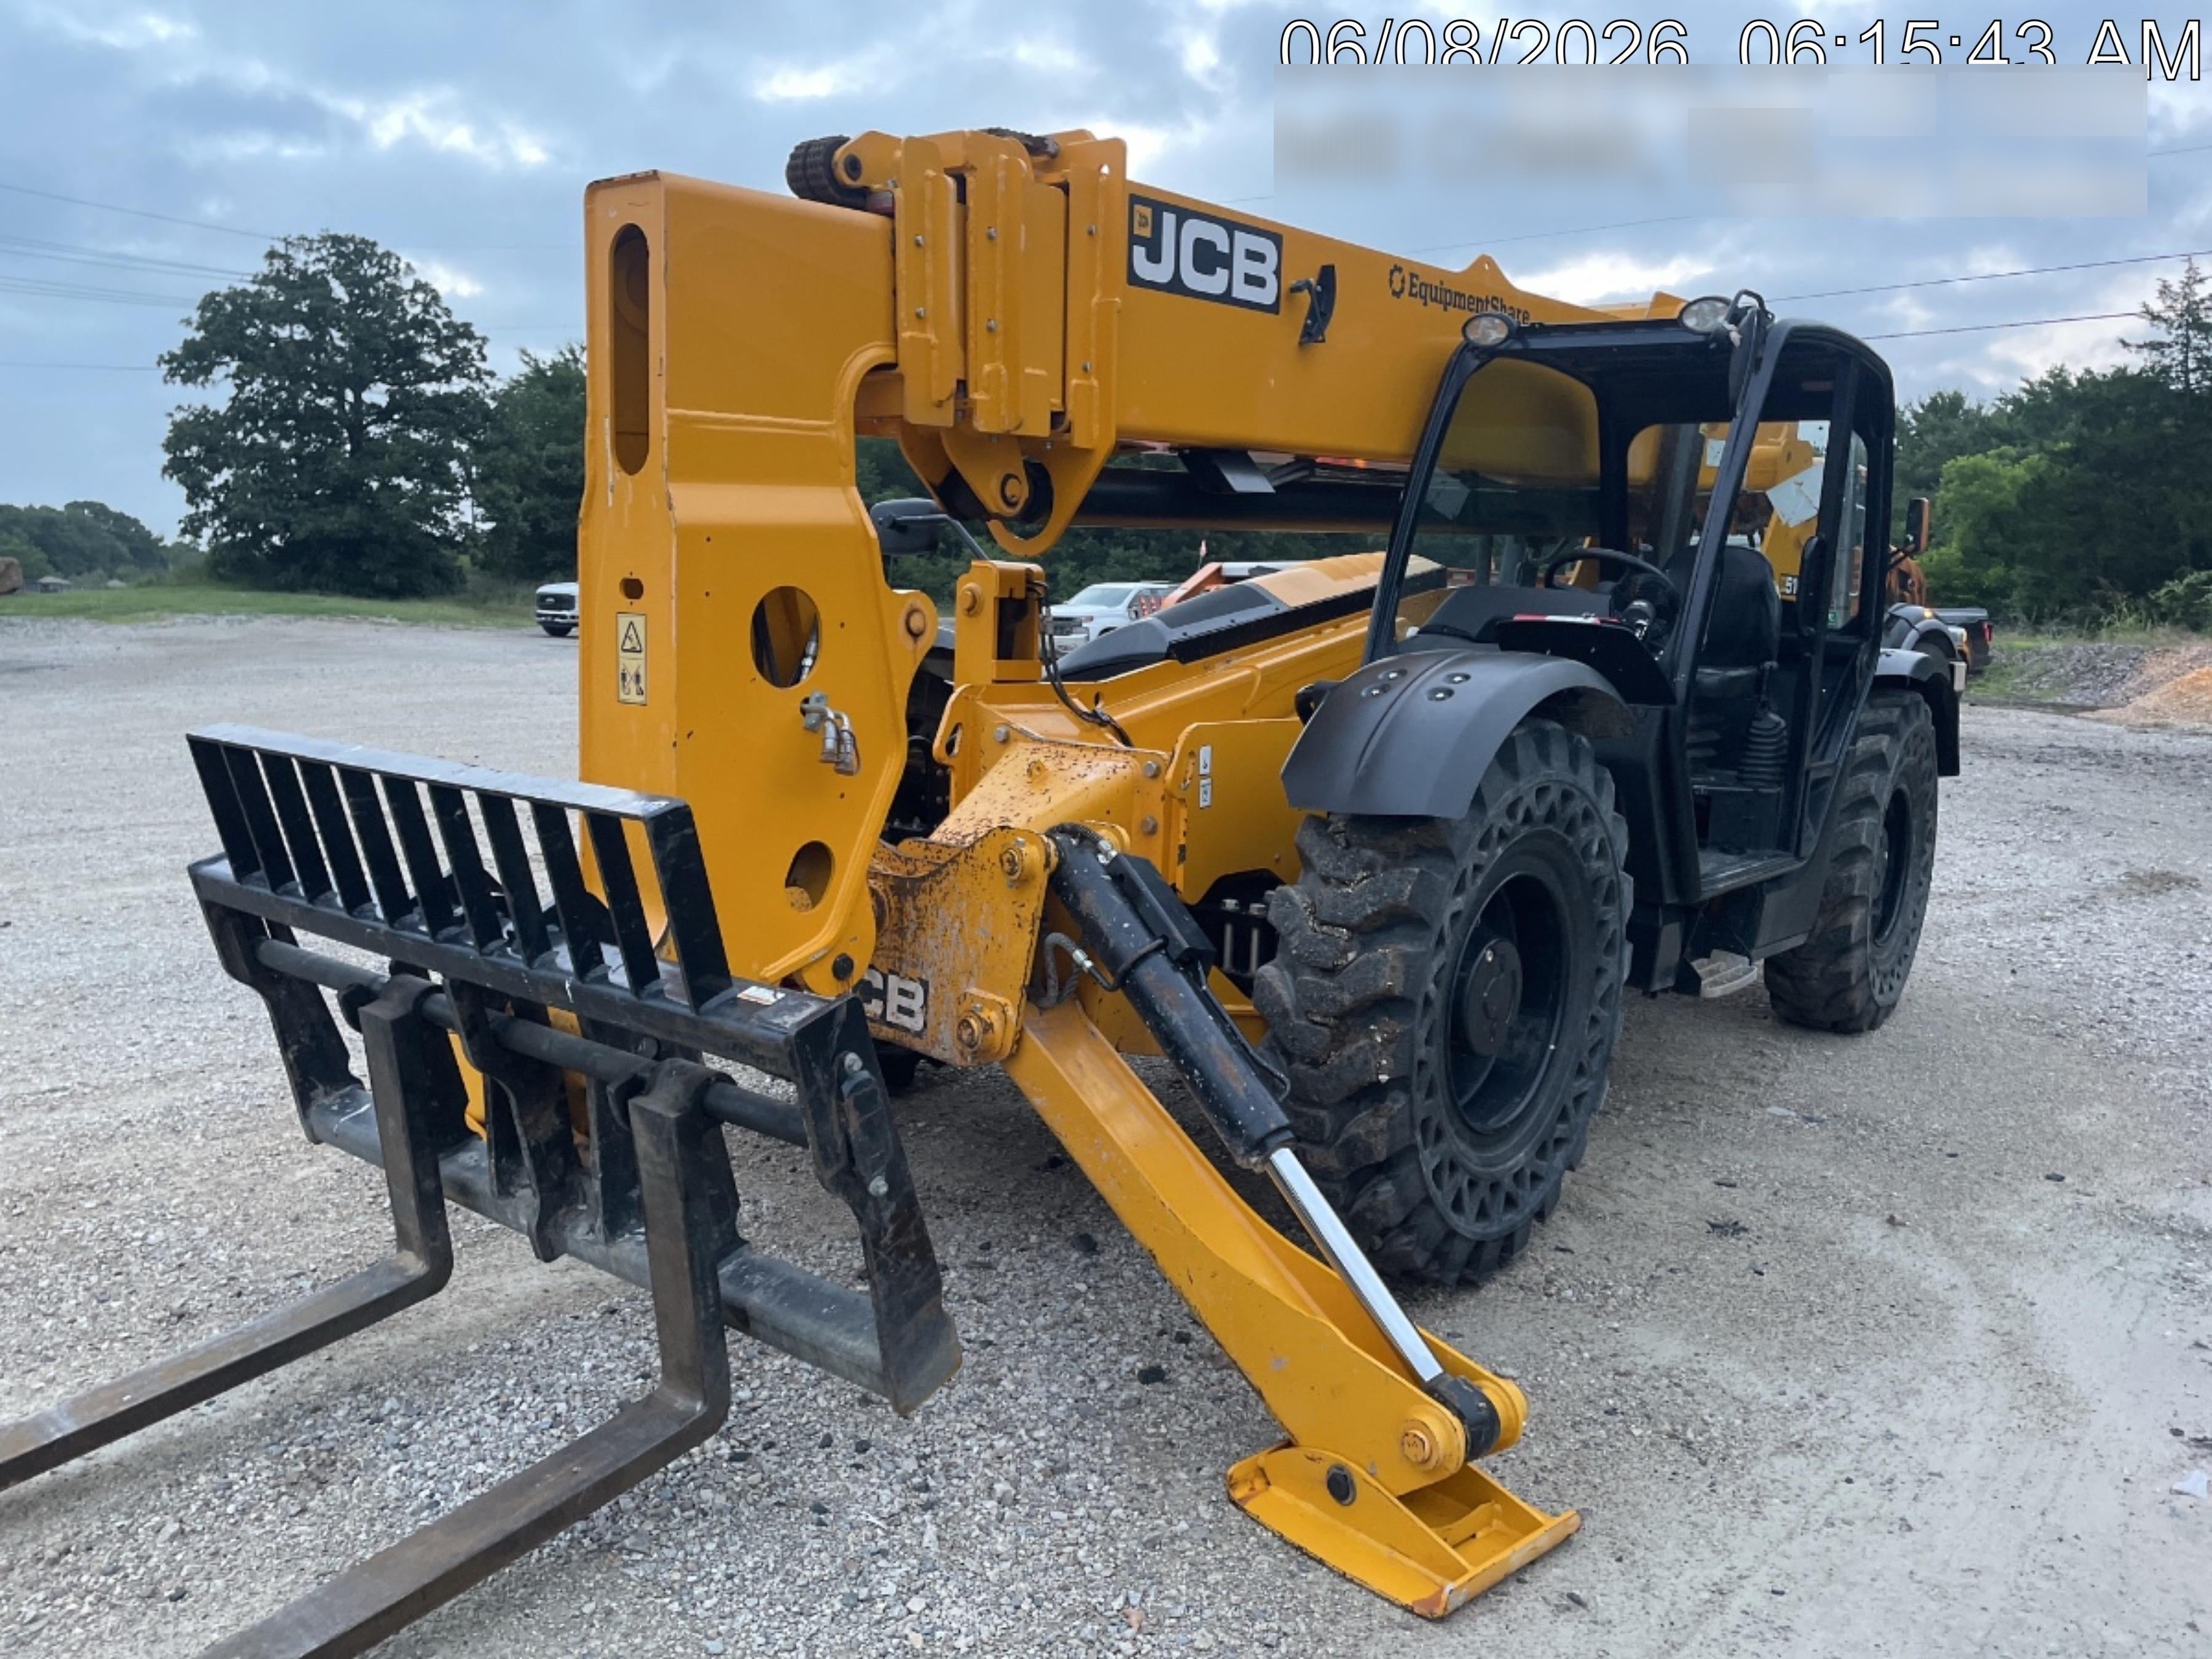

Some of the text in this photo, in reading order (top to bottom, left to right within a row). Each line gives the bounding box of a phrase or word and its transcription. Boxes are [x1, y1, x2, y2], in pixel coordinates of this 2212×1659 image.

[1132, 211, 1279, 305] JCB
[1408, 272, 1531, 325] EquipmentShare
[850, 968, 925, 1032] CB
